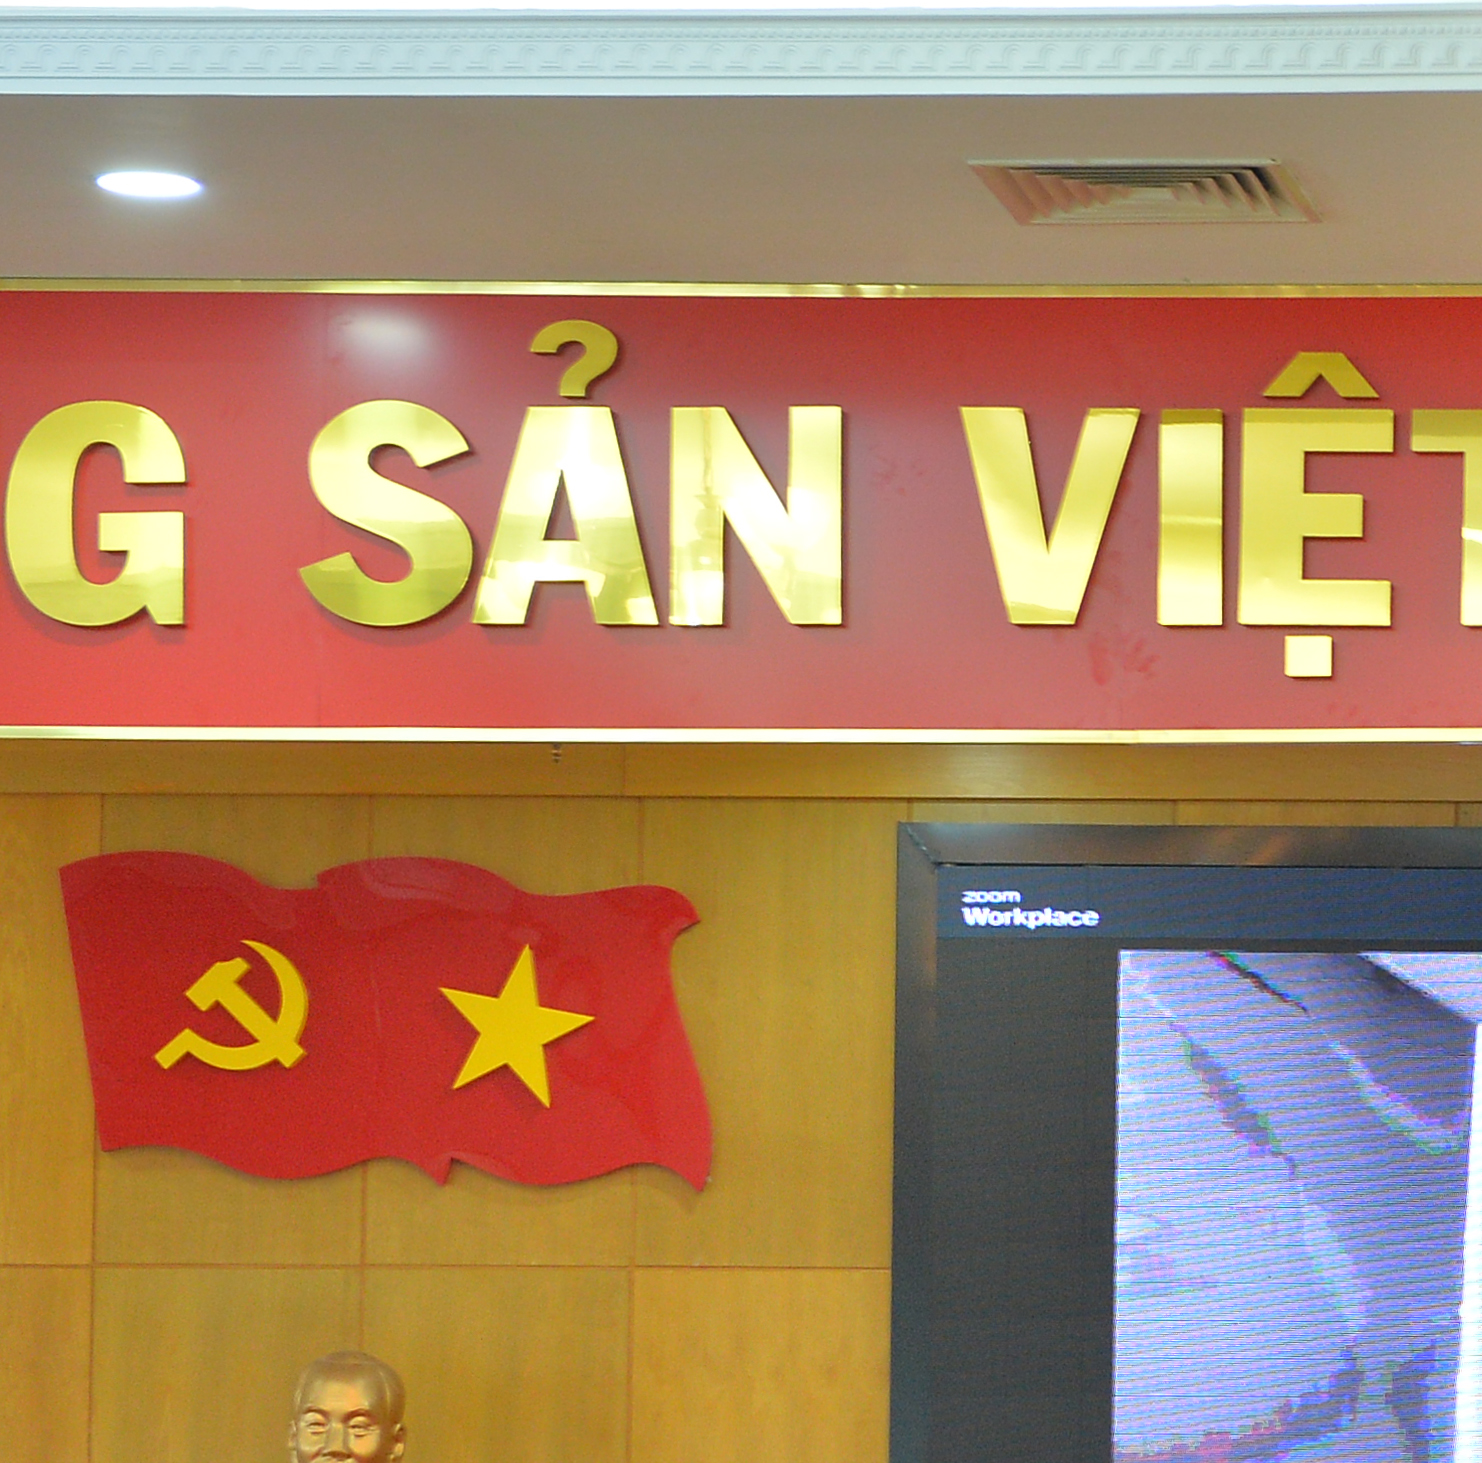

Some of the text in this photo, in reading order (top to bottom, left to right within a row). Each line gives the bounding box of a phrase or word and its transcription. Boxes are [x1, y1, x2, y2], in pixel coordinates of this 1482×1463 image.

[299, 319, 843, 627] SẢN
[961, 890, 1022, 904] zoom
[961, 907, 1101, 930] Workplace
